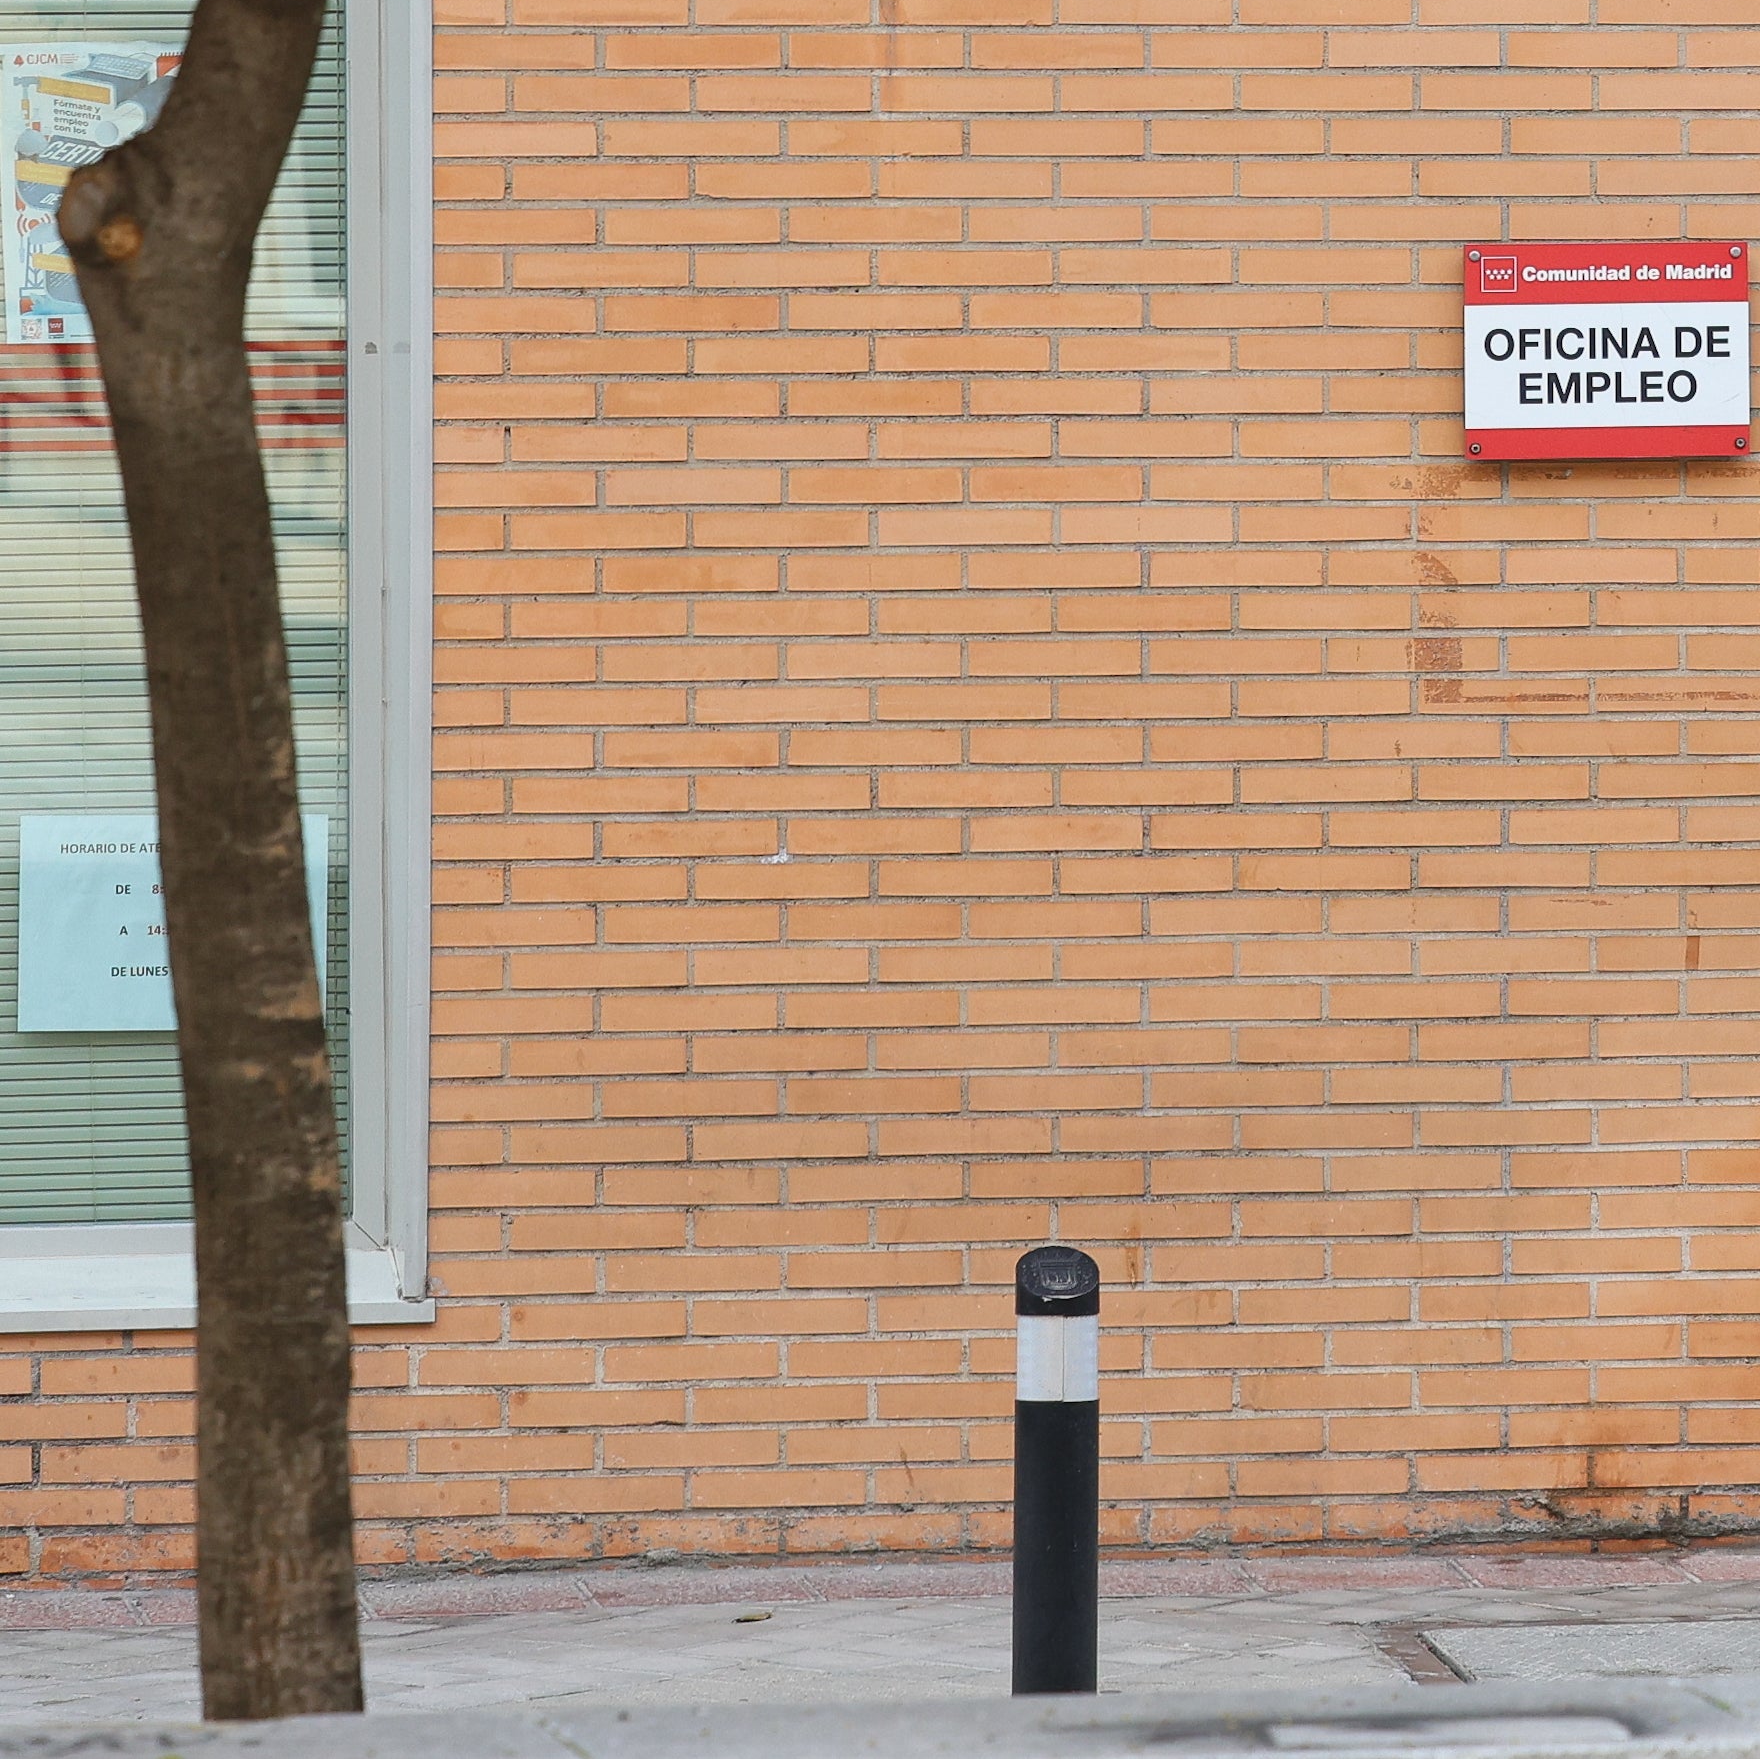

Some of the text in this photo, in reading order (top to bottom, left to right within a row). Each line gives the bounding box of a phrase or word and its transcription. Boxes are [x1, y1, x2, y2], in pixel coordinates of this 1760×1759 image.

[27, 54, 58, 64] CJCM
[54, 99, 101, 114] Fórmate y
[54, 109, 102, 121] encuentra
[54, 117, 89, 130] empleo
[54, 125, 87, 136] con los
[1522, 264, 1733, 282] Comunidad de Madrid
[1484, 326, 1730, 362] OFICINA DE
[1519, 369, 1698, 404] EMPLEO
[60, 843, 117, 854] HORARIO
[120, 843, 136, 853] DE
[116, 884, 165, 895] DE 8:
[120, 925, 169, 936] A 14:
[111, 966, 169, 977] DE LUNES
